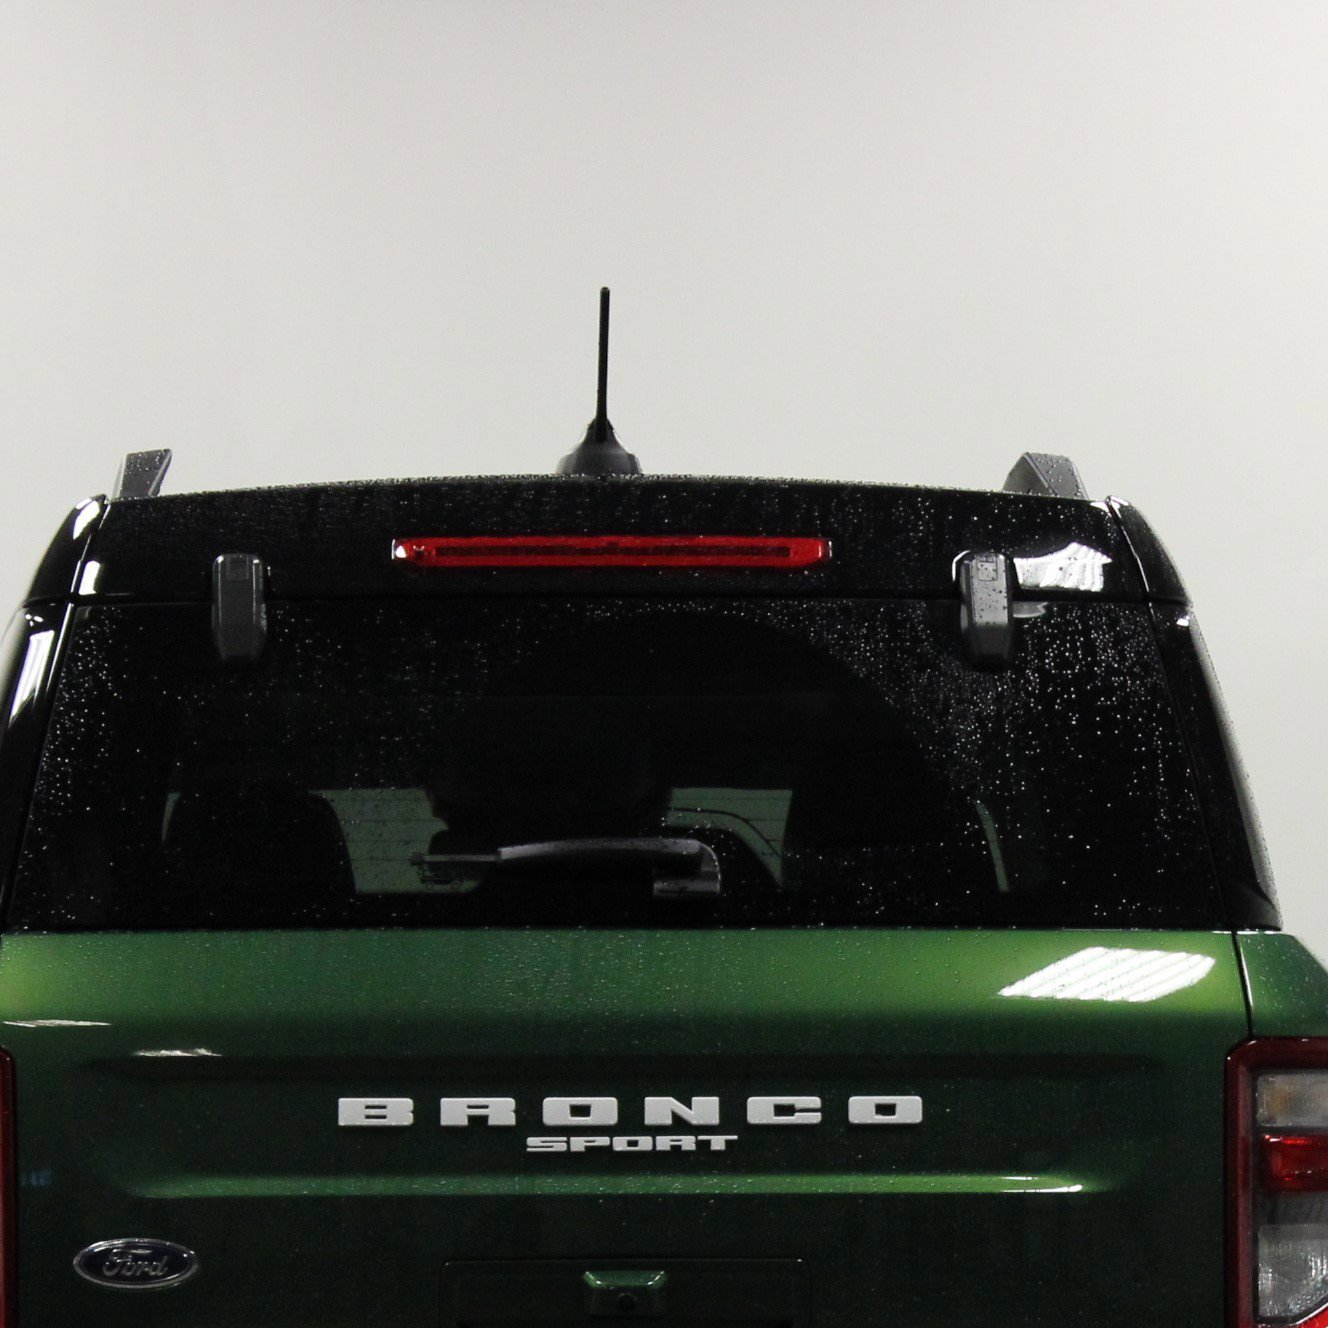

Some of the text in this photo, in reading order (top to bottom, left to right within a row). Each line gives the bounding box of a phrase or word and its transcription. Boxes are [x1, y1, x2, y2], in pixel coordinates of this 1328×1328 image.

[337, 1095, 924, 1127] BRONCO
[526, 1135, 738, 1152] SPORT
[102, 1249, 169, 1277] Ford
